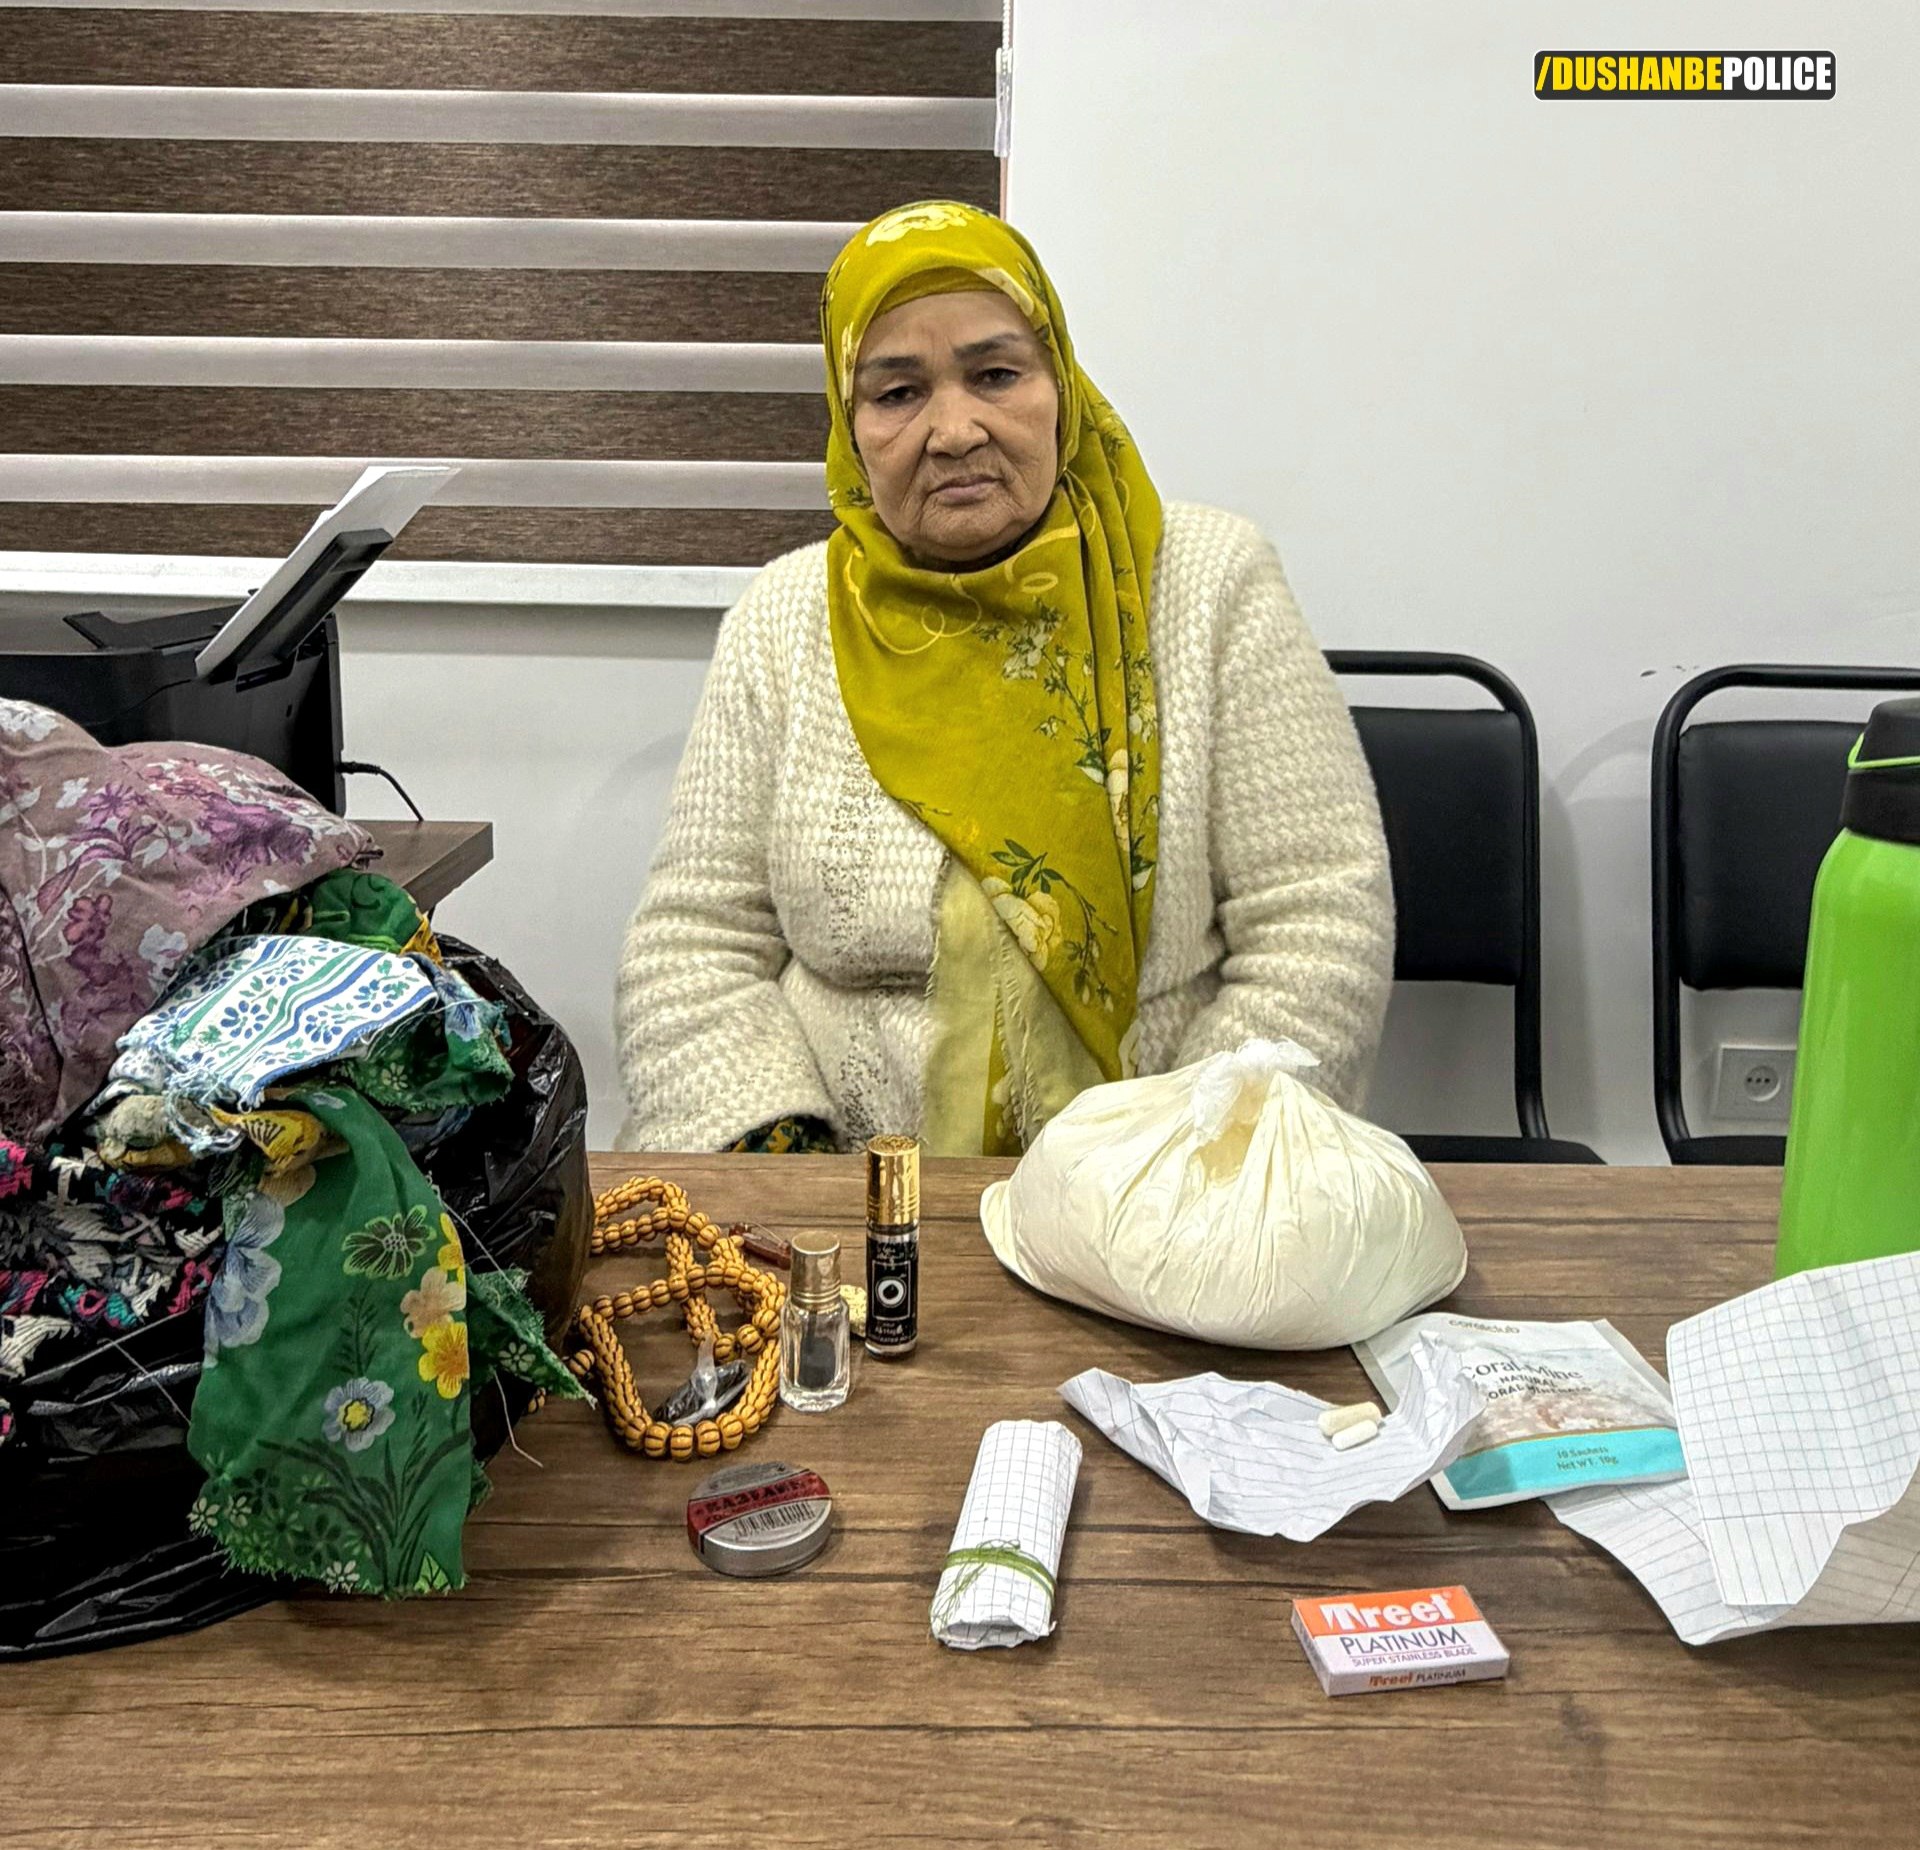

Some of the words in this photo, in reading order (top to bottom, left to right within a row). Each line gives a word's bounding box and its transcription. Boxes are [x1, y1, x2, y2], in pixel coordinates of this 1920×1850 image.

[1500, 1374, 1558, 1387] NATURAL
[1487, 1384, 1524, 1400] ORAL
[1319, 1593, 1455, 1631] Treet
[1340, 1626, 1466, 1655] PLATINUM
[1352, 1656, 1387, 1668] SUPER
[1389, 1650, 1443, 1664] STAINLESS
[1445, 1646, 1477, 1659] BLADE
[1416, 1668, 1466, 1682] PLATINUM
